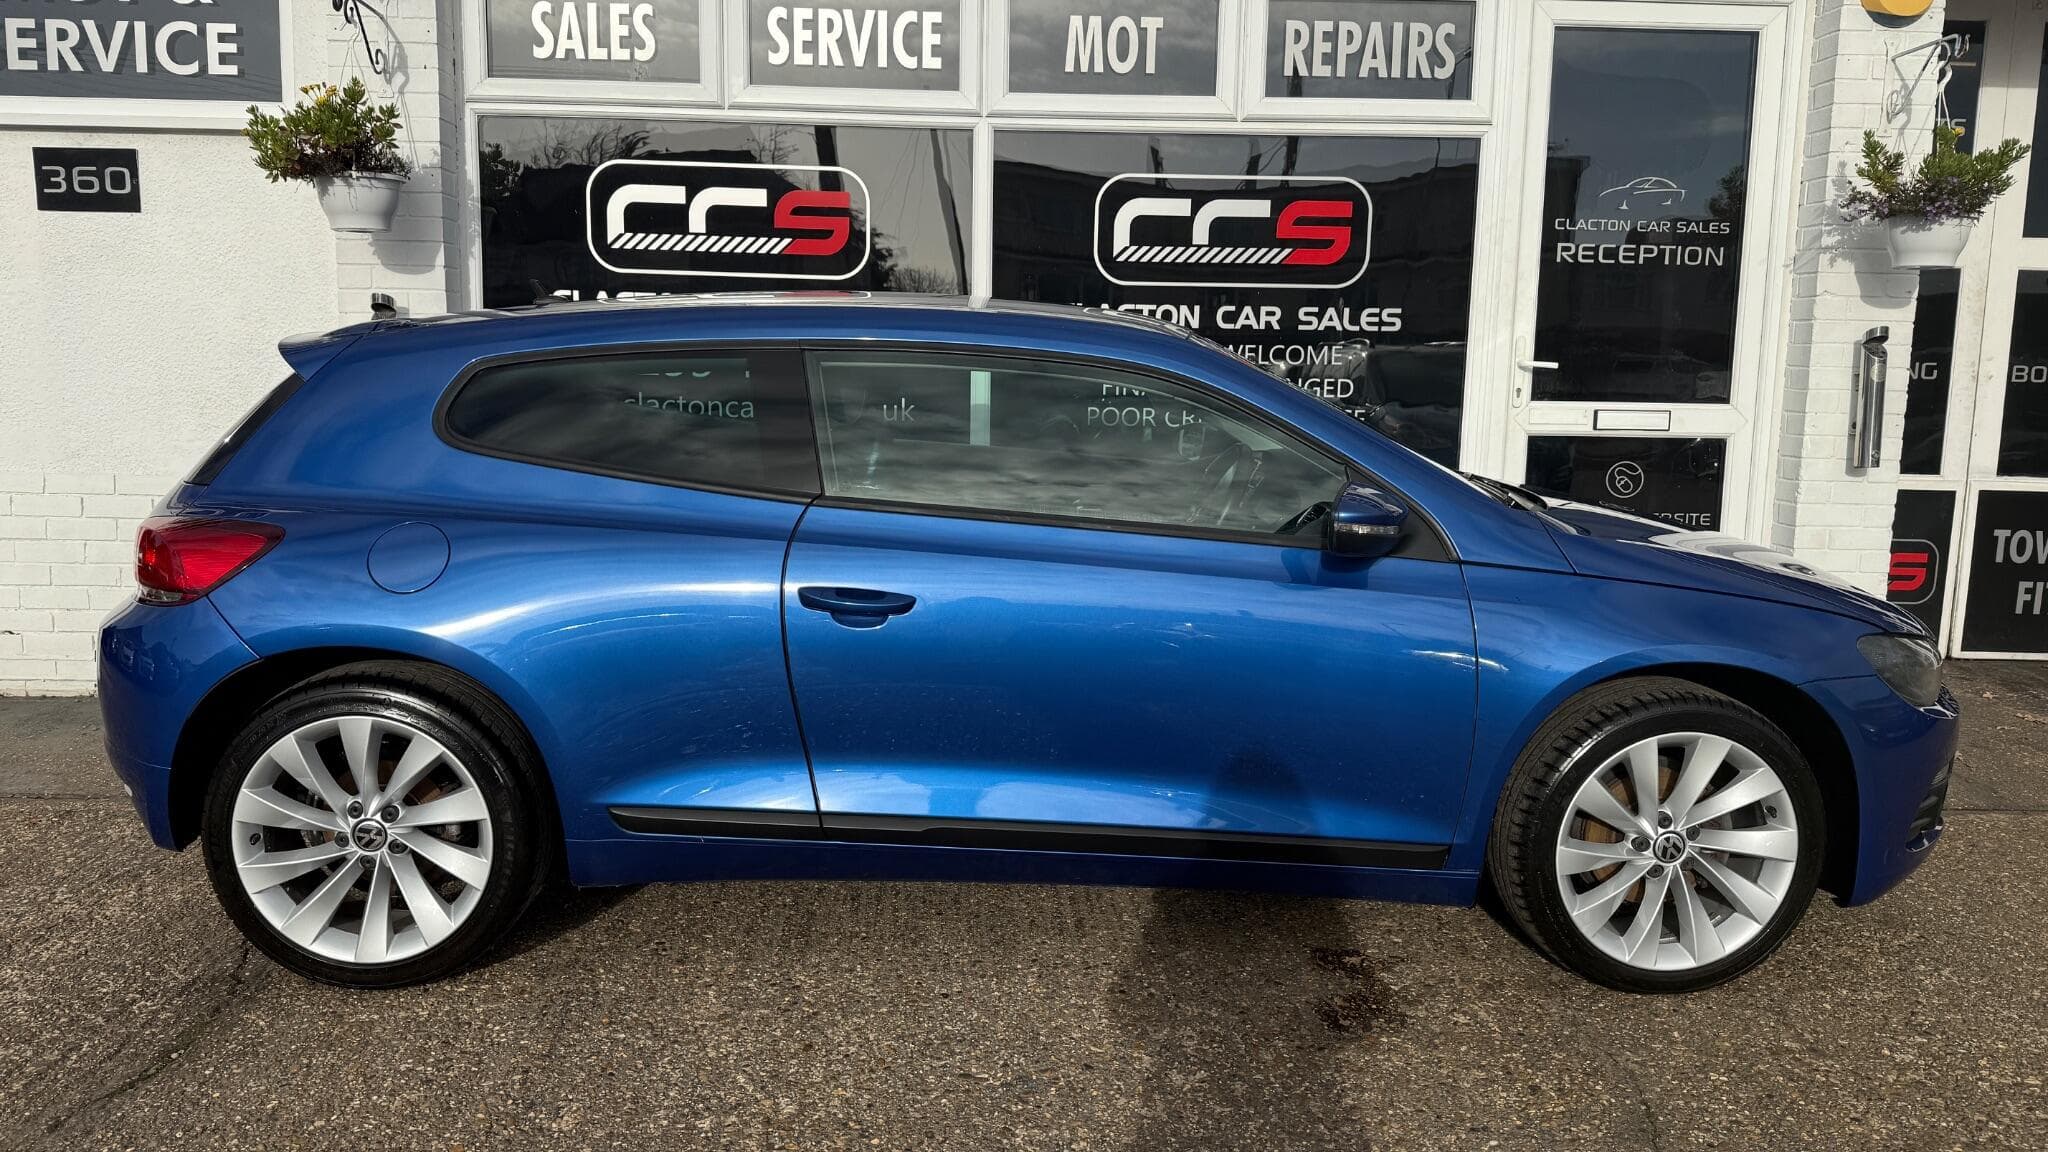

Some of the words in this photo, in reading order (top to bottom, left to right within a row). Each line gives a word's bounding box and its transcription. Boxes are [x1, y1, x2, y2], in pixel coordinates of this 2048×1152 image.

[531, 1, 656, 63] SALES
[767, 6, 943, 70] SERVICE
[1064, 15, 1164, 75] MOT
[1283, 20, 1456, 80] REPAIRS
[42, 165, 132, 195] 360
[1555, 218, 1631, 232] CLACTON
[1637, 220, 1671, 233] CAR
[1676, 221, 1731, 234] SALES
[1556, 242, 1724, 266] RECEPTION
[1216, 305, 1282, 330] CAR
[1298, 306, 1402, 332] SALES
[1087, 406, 1157, 427] POOR
